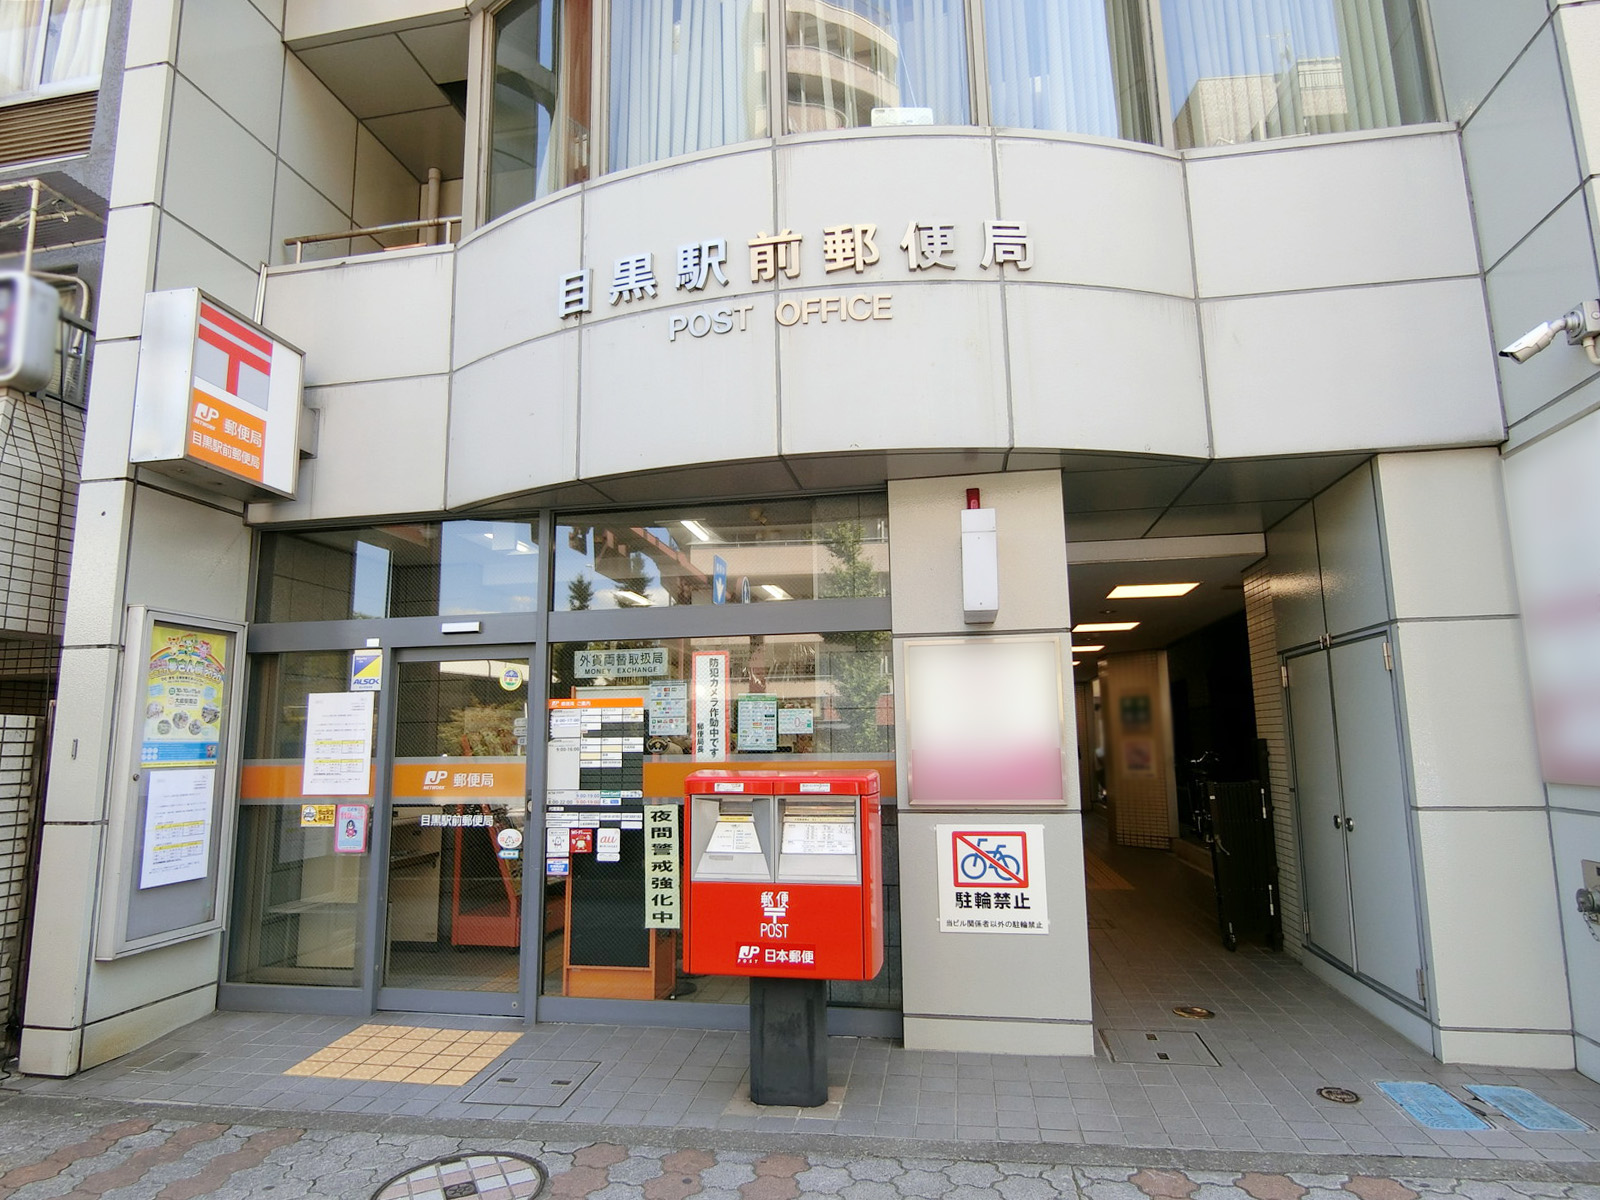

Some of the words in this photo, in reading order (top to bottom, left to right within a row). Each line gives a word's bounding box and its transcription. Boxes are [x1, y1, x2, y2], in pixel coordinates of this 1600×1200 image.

[559, 220, 1034, 320] 目黒駅前郵便局
[668, 305, 753, 342] POST
[775, 294, 893, 327] OFFICE
[224, 418, 262, 448] 郵便局
[192, 430, 260, 470] 目黒駅前郵便局
[579, 651, 663, 668] 外貨両替取扱局
[616, 666, 658, 674] EXCHANGE
[353, 678, 380, 686] ALSOK
[709, 657, 720, 758] 防犯カメラ作動中です
[424, 770, 448, 785] JP
[453, 773, 494, 788] 郵便局
[421, 814, 494, 827] 目黒駅前郵便局
[600, 835, 617, 844] au
[650, 810, 673, 923] 夜間警戒強化中
[760, 891, 789, 908] 郵便
[955, 891, 1031, 909] 駐輪禁止
[760, 922, 789, 938] POST
[946, 919, 1044, 929] 当ビル関係者以外の駐輪禁止
[738, 945, 760, 959] JP
[765, 948, 814, 964] 日本郵便
